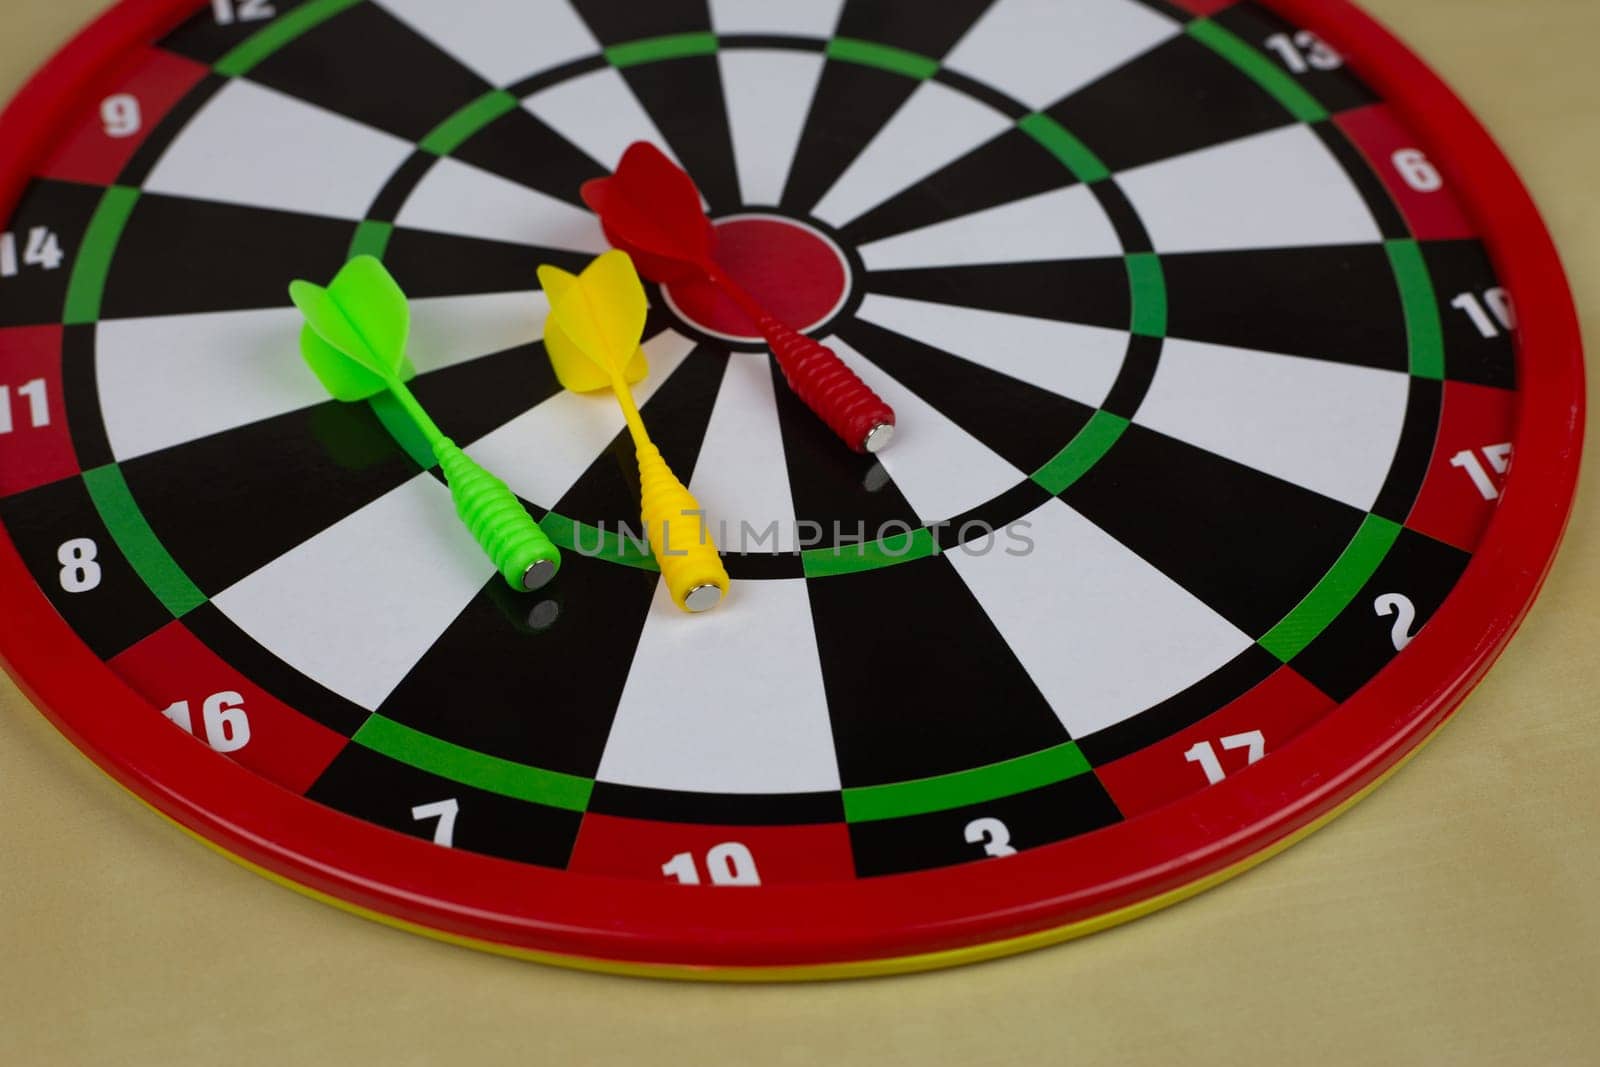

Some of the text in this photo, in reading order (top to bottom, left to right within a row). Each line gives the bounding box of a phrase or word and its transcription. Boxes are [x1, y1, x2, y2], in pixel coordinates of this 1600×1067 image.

[1267, 32, 1342, 73] 13
[102, 94, 141, 137] 9
[1393, 148, 1441, 191] 6
[0, 227, 64, 277] 14
[58, 537, 102, 593] 8
[1374, 592, 1416, 651] 2
[1184, 729, 1266, 785] 17
[412, 798, 459, 848] 7
[965, 817, 1018, 858] 3
